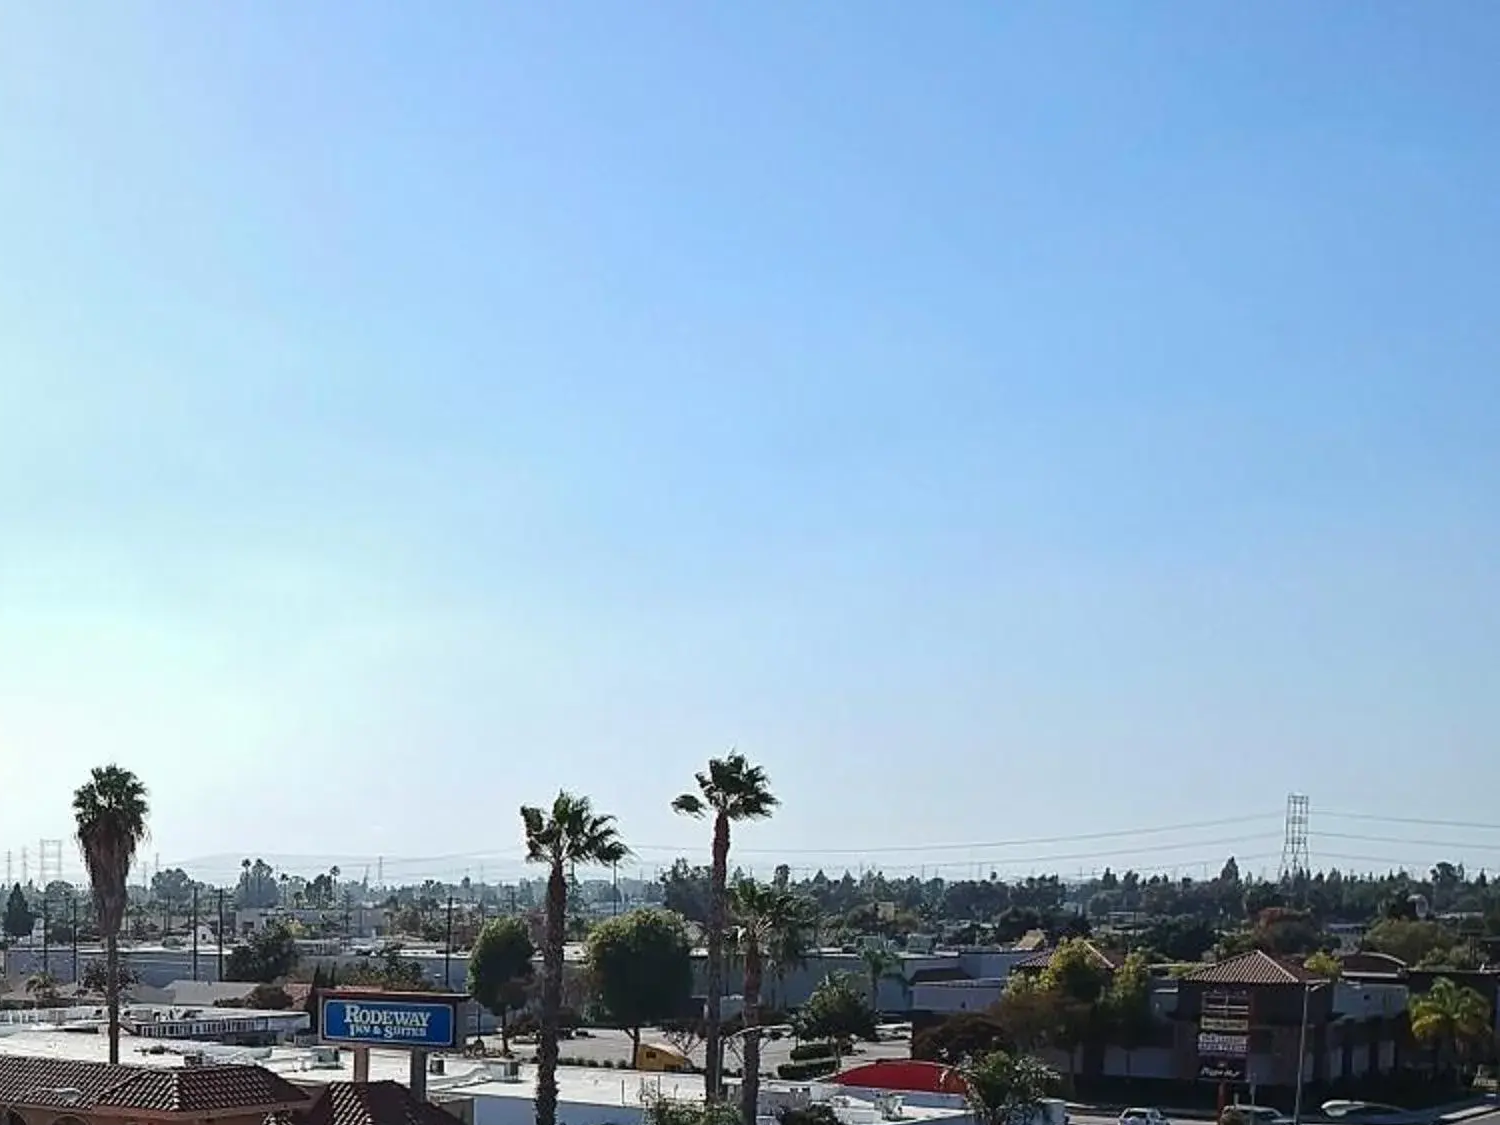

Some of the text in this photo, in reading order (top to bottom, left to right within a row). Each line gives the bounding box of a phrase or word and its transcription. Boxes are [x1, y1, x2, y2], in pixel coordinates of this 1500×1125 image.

[344, 1004, 431, 1027] RODEWAY
[350, 1025, 427, 1039] INN & SUITES
